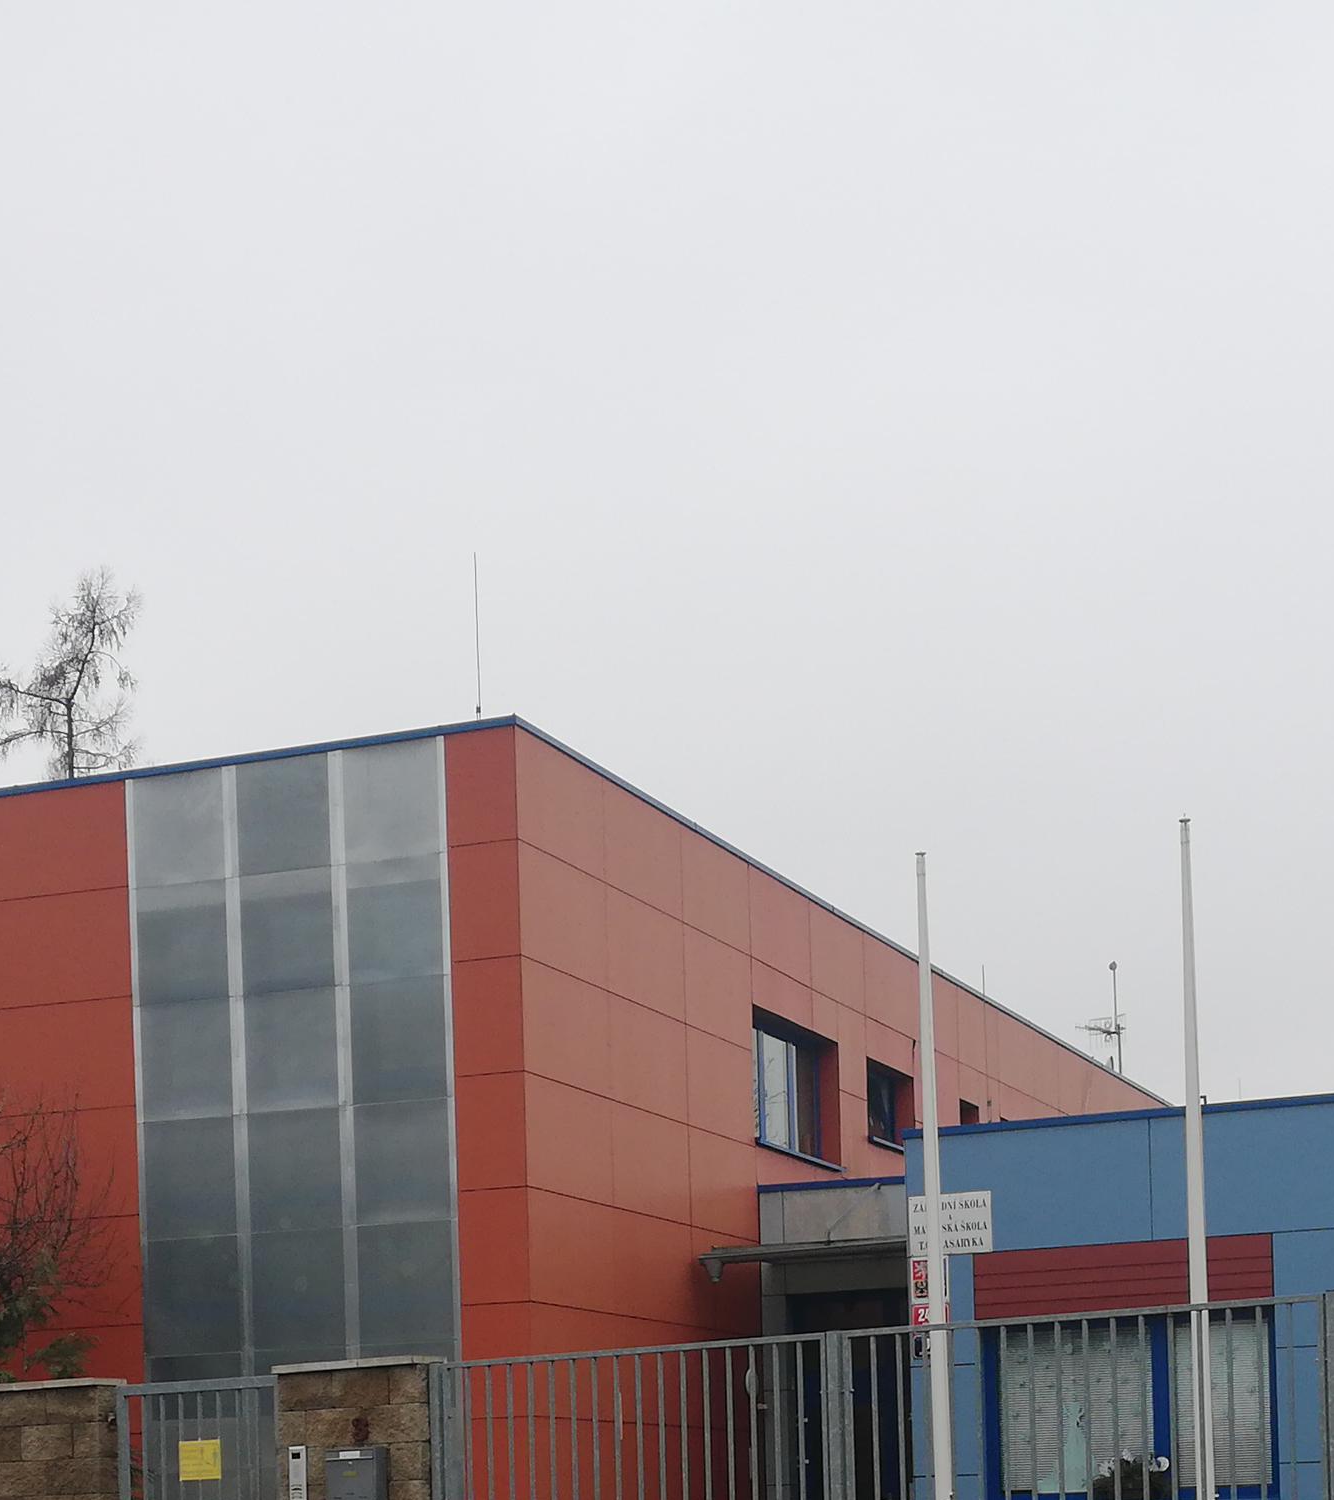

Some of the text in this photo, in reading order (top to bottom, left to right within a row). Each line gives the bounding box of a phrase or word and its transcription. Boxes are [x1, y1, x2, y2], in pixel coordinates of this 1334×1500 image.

[913, 1197, 987, 1213] ZÁDNÍ ŠKOLA
[913, 1220, 988, 1235] MASKÁ ŠKOLA
[943, 1236, 983, 1249] ASARYKA
